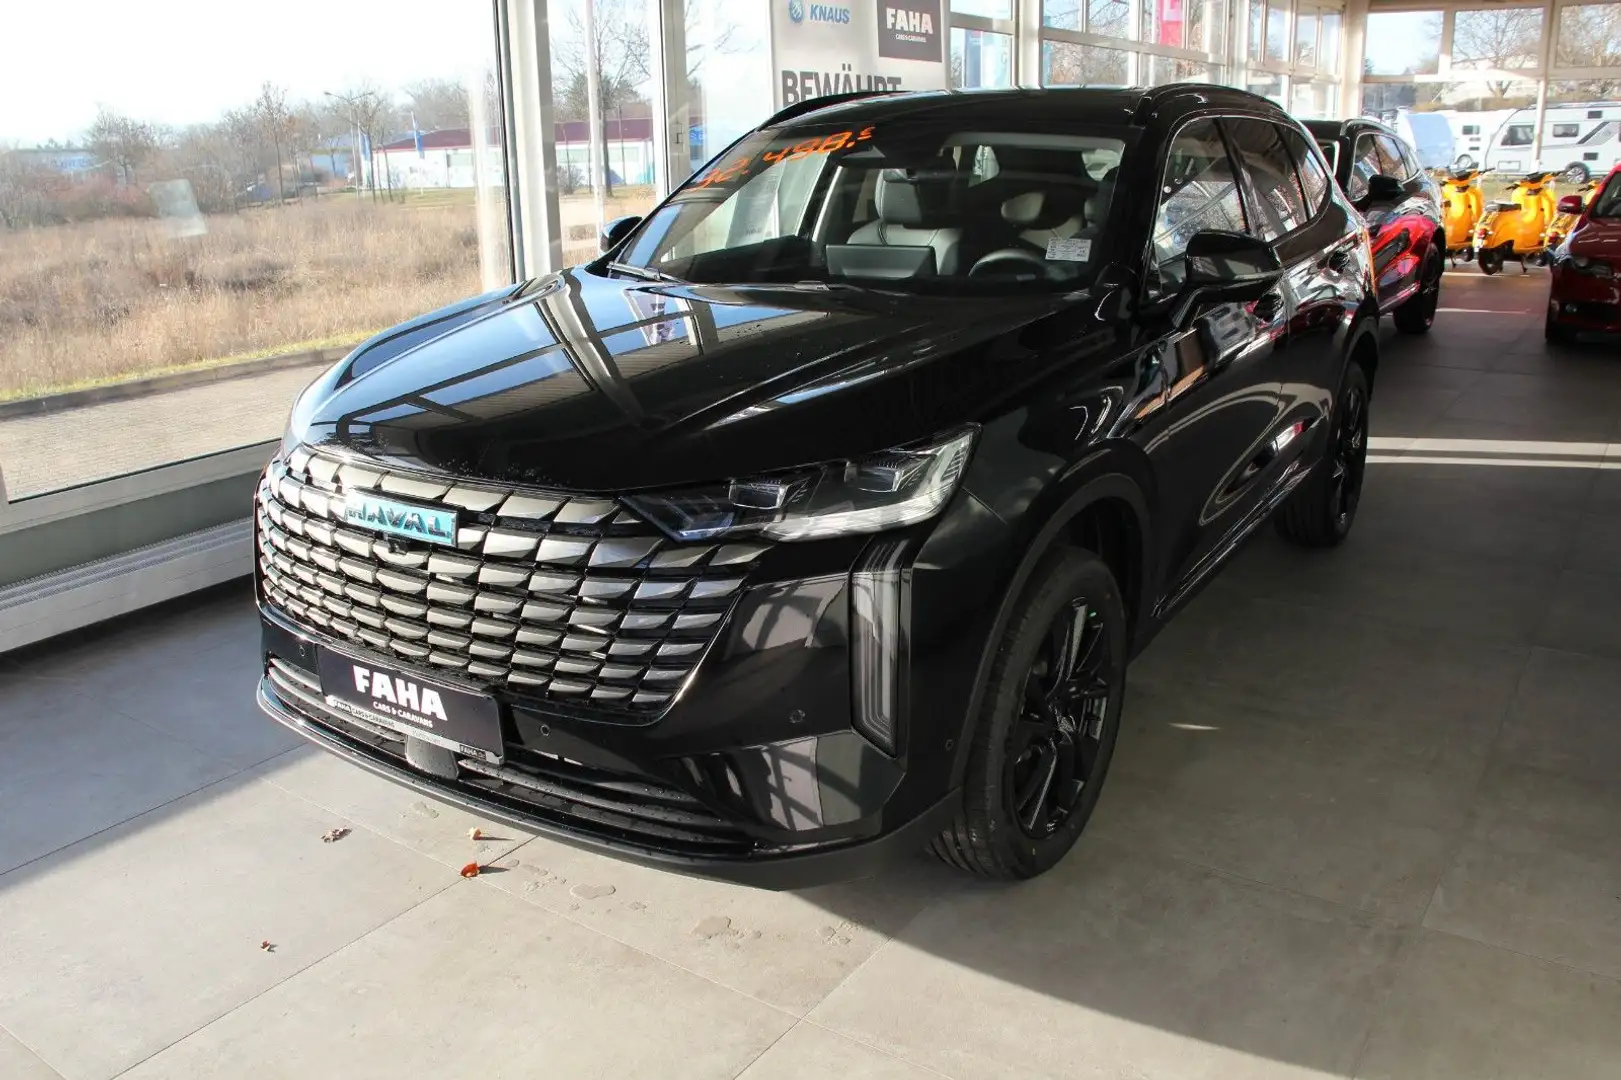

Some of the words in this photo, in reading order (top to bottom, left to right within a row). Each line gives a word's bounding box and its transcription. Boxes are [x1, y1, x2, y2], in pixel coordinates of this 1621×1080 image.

[810, 4, 850, 24] KNAUS
[886, 7, 934, 34] FAHA
[352, 665, 447, 721] FAHA
[373, 701, 391, 714] CARS
